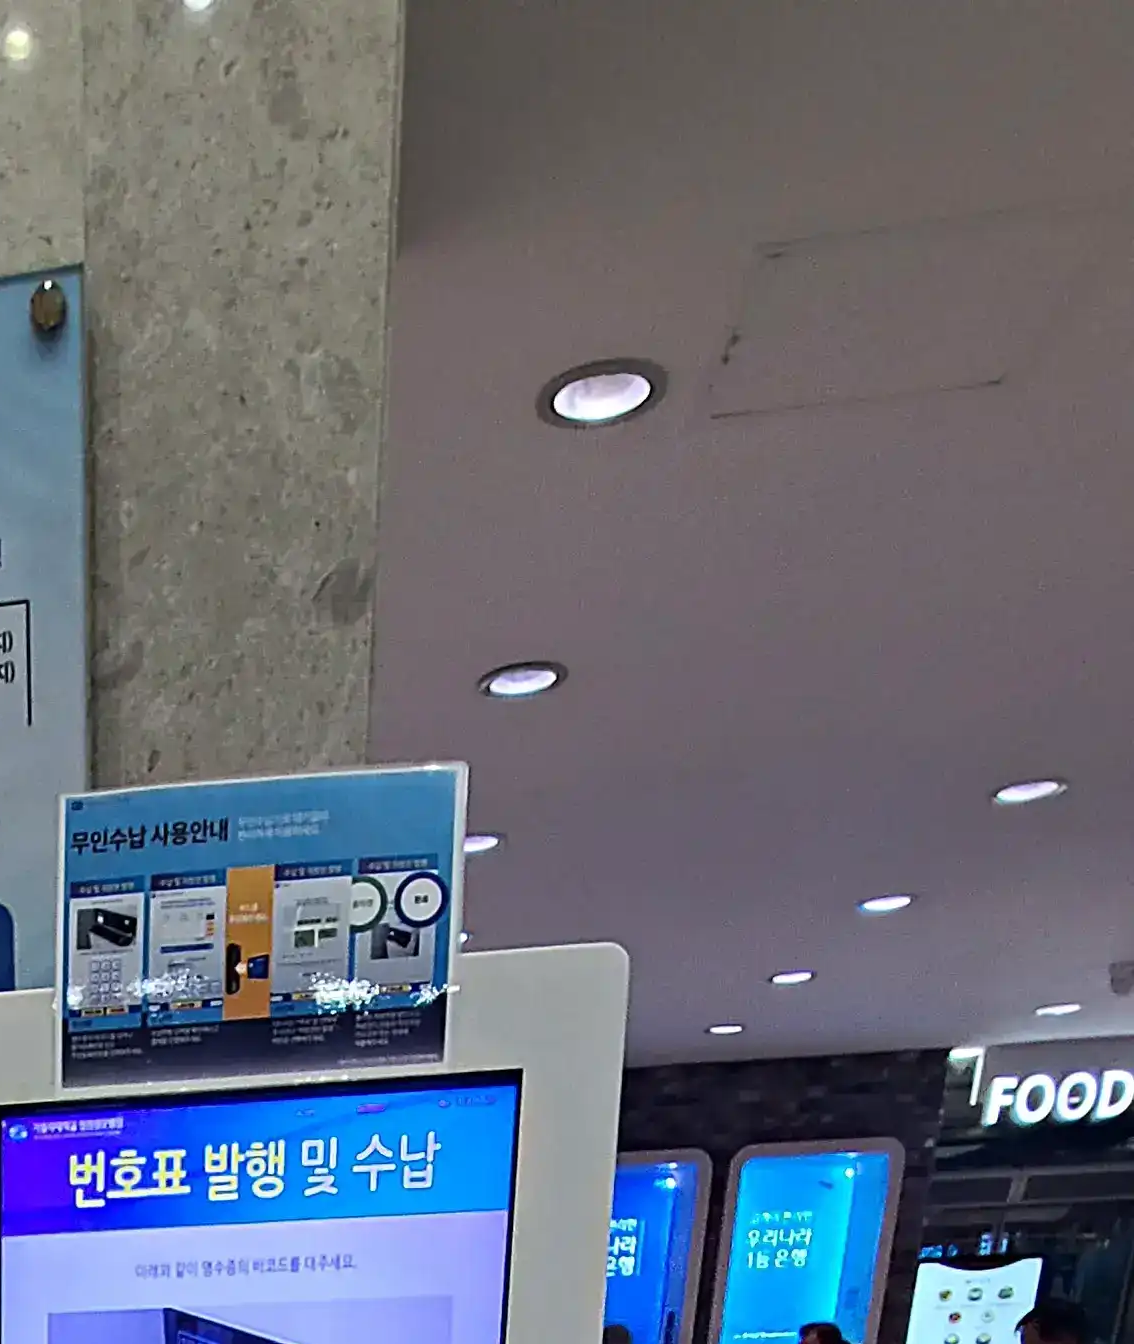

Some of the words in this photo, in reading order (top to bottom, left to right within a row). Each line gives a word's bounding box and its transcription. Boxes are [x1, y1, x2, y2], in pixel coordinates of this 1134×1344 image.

[71, 825, 147, 854] 무인수납
[151, 816, 229, 846] 사용안내
[981, 1069, 1134, 1127] FOOD
[68, 1149, 191, 1208] 번호표
[204, 1140, 287, 1201] 발행
[300, 1136, 340, 1197] 및
[353, 1131, 442, 1191] 수납
[747, 1227, 814, 1249] 우리나라
